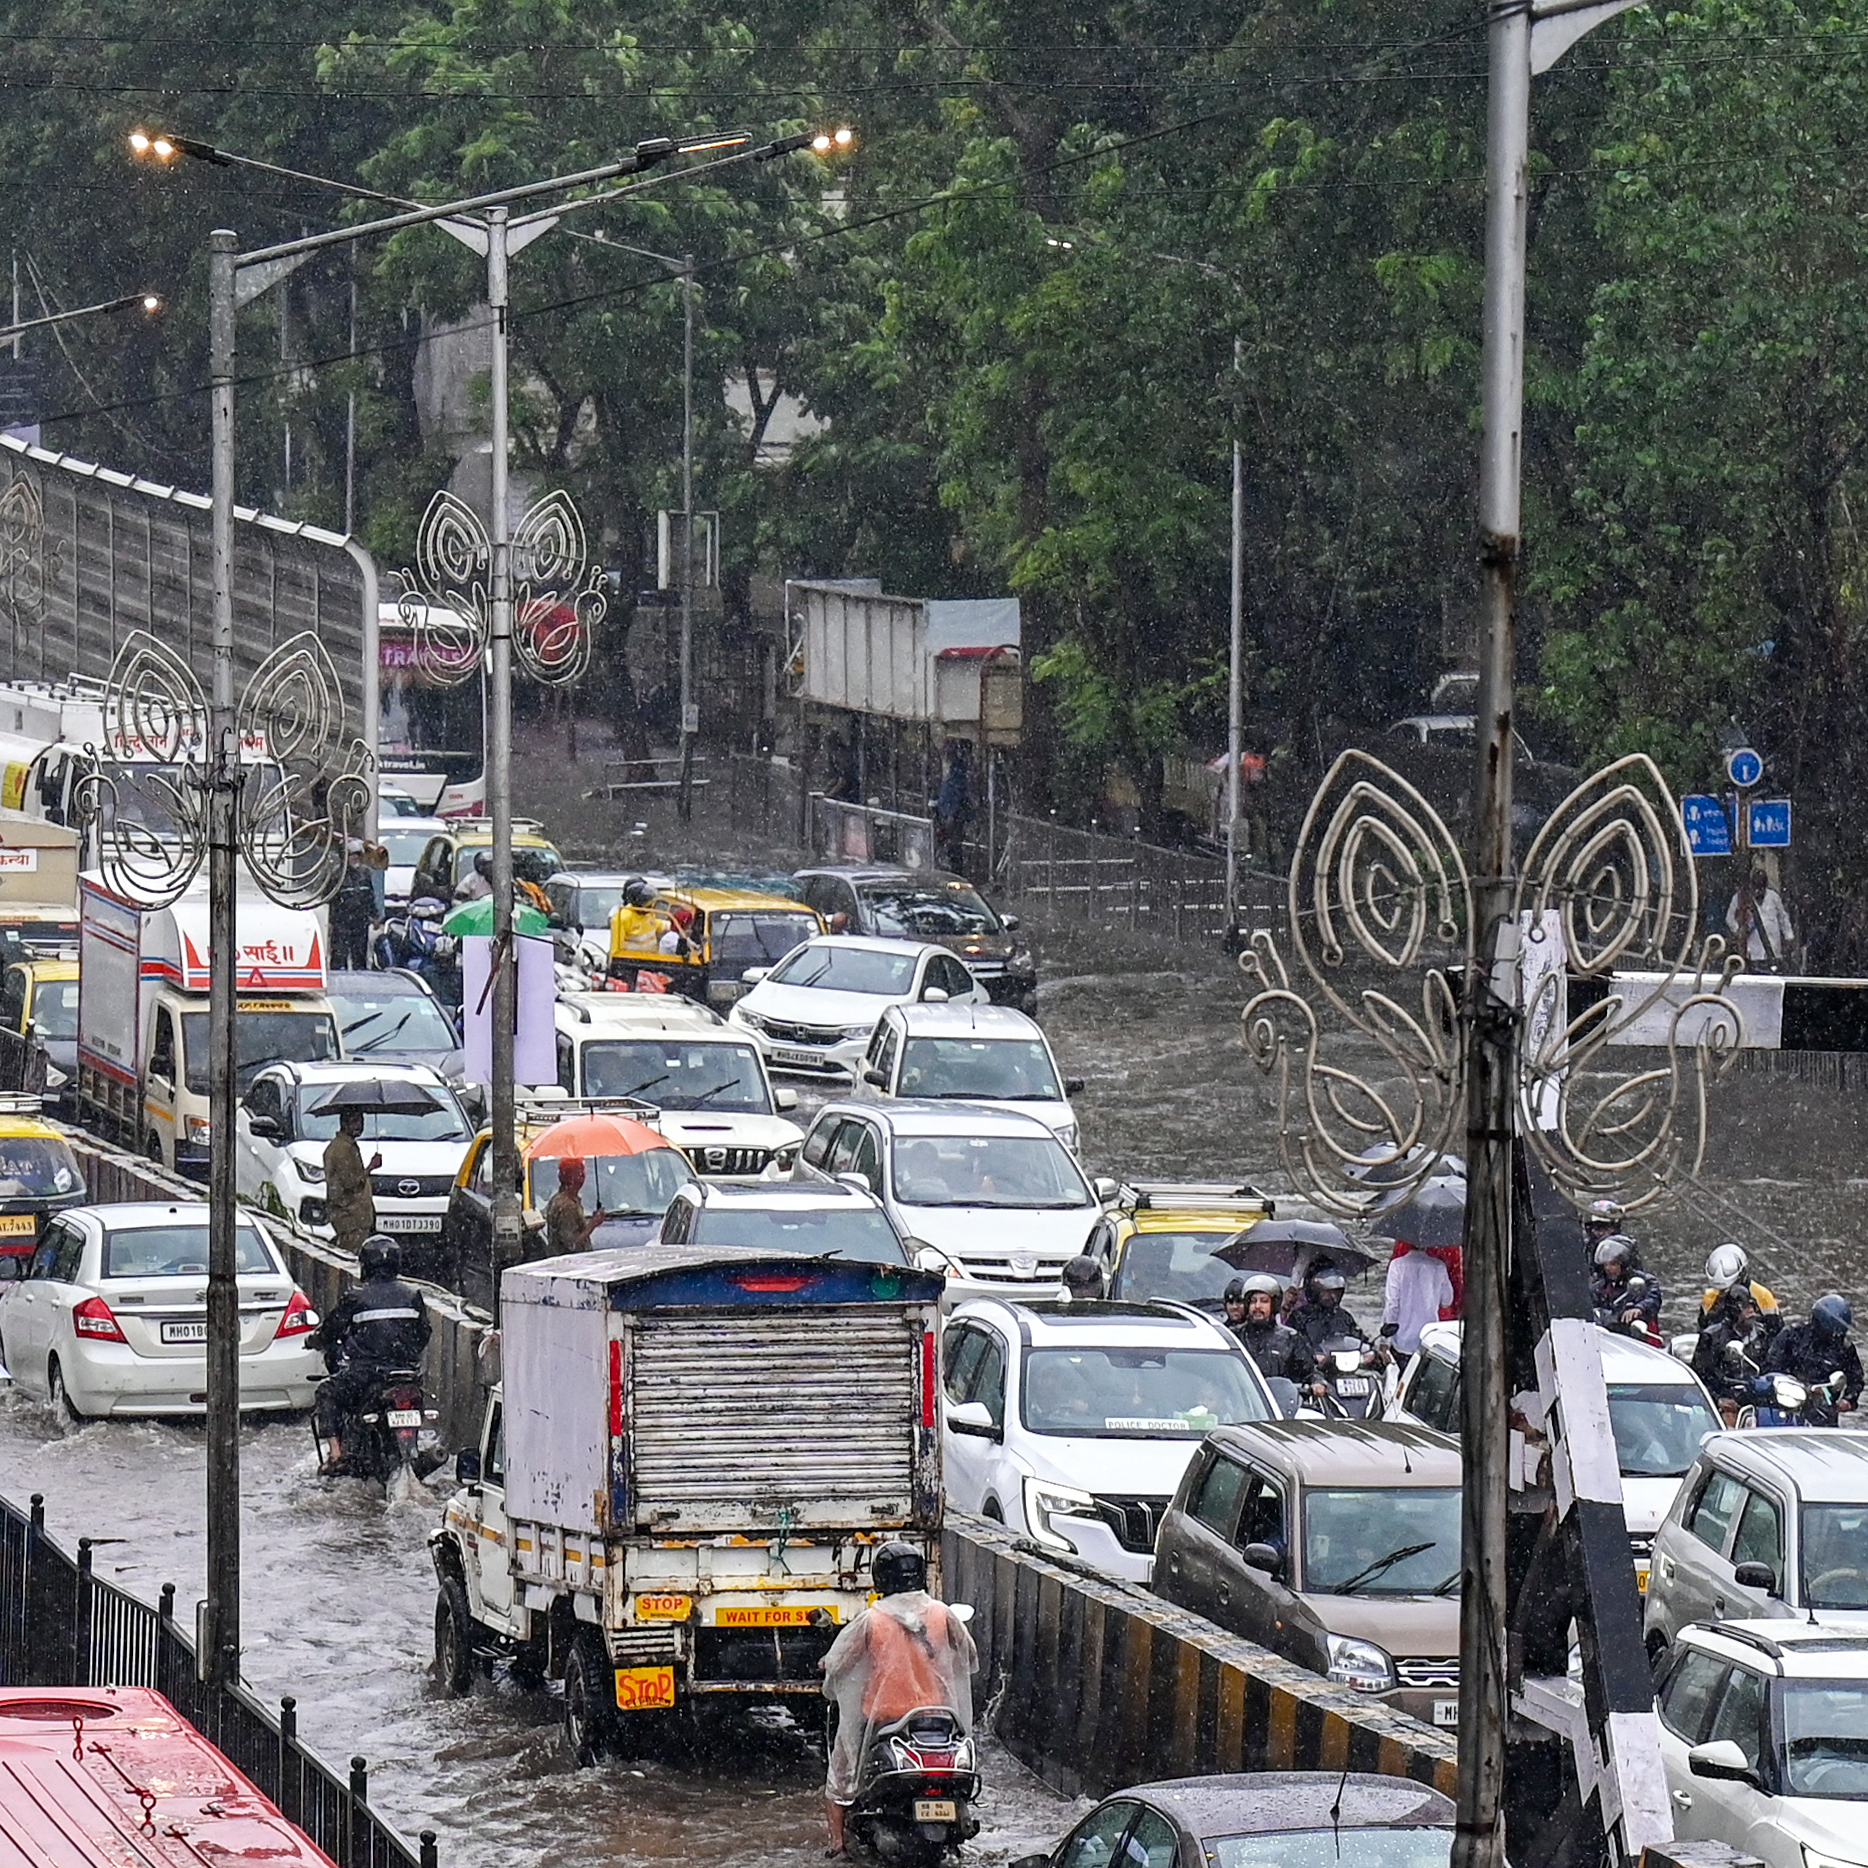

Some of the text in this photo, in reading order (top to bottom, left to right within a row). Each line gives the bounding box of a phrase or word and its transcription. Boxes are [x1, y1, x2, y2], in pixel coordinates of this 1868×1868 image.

[1107, 1420, 1186, 1431] POLICE DOCTOR
[642, 1598, 683, 1610] STOP
[726, 1611, 761, 1622] WAIT
[764, 1611, 792, 1622] FOR
[618, 1673, 672, 1706] STOP
